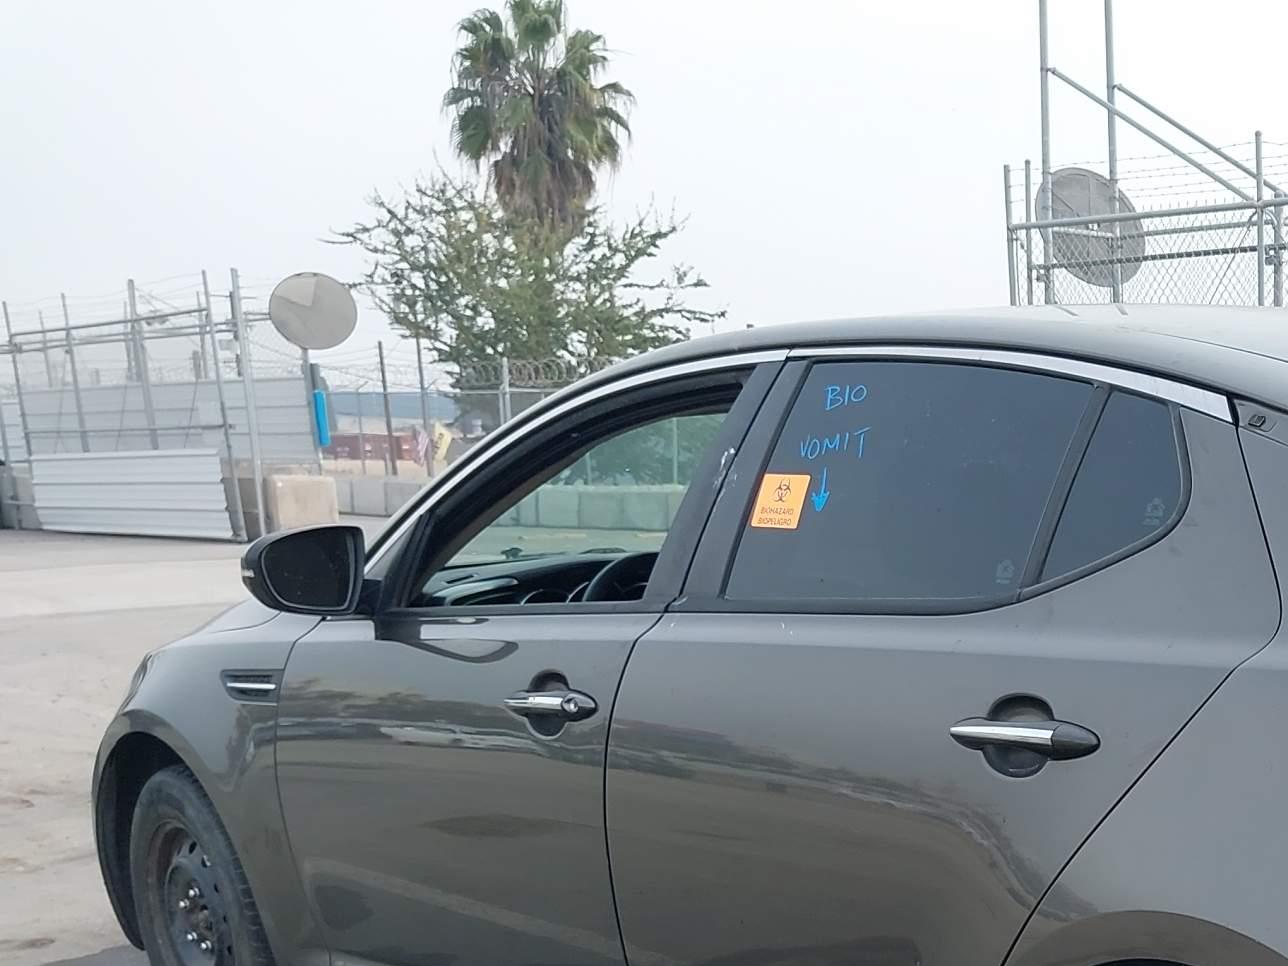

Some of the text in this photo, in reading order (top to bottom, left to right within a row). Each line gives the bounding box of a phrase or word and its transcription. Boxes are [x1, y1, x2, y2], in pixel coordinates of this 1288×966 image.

[824, 384, 868, 411] BIO
[800, 427, 872, 460] VOMIT
[760, 506, 795, 515] BIOHAZARD
